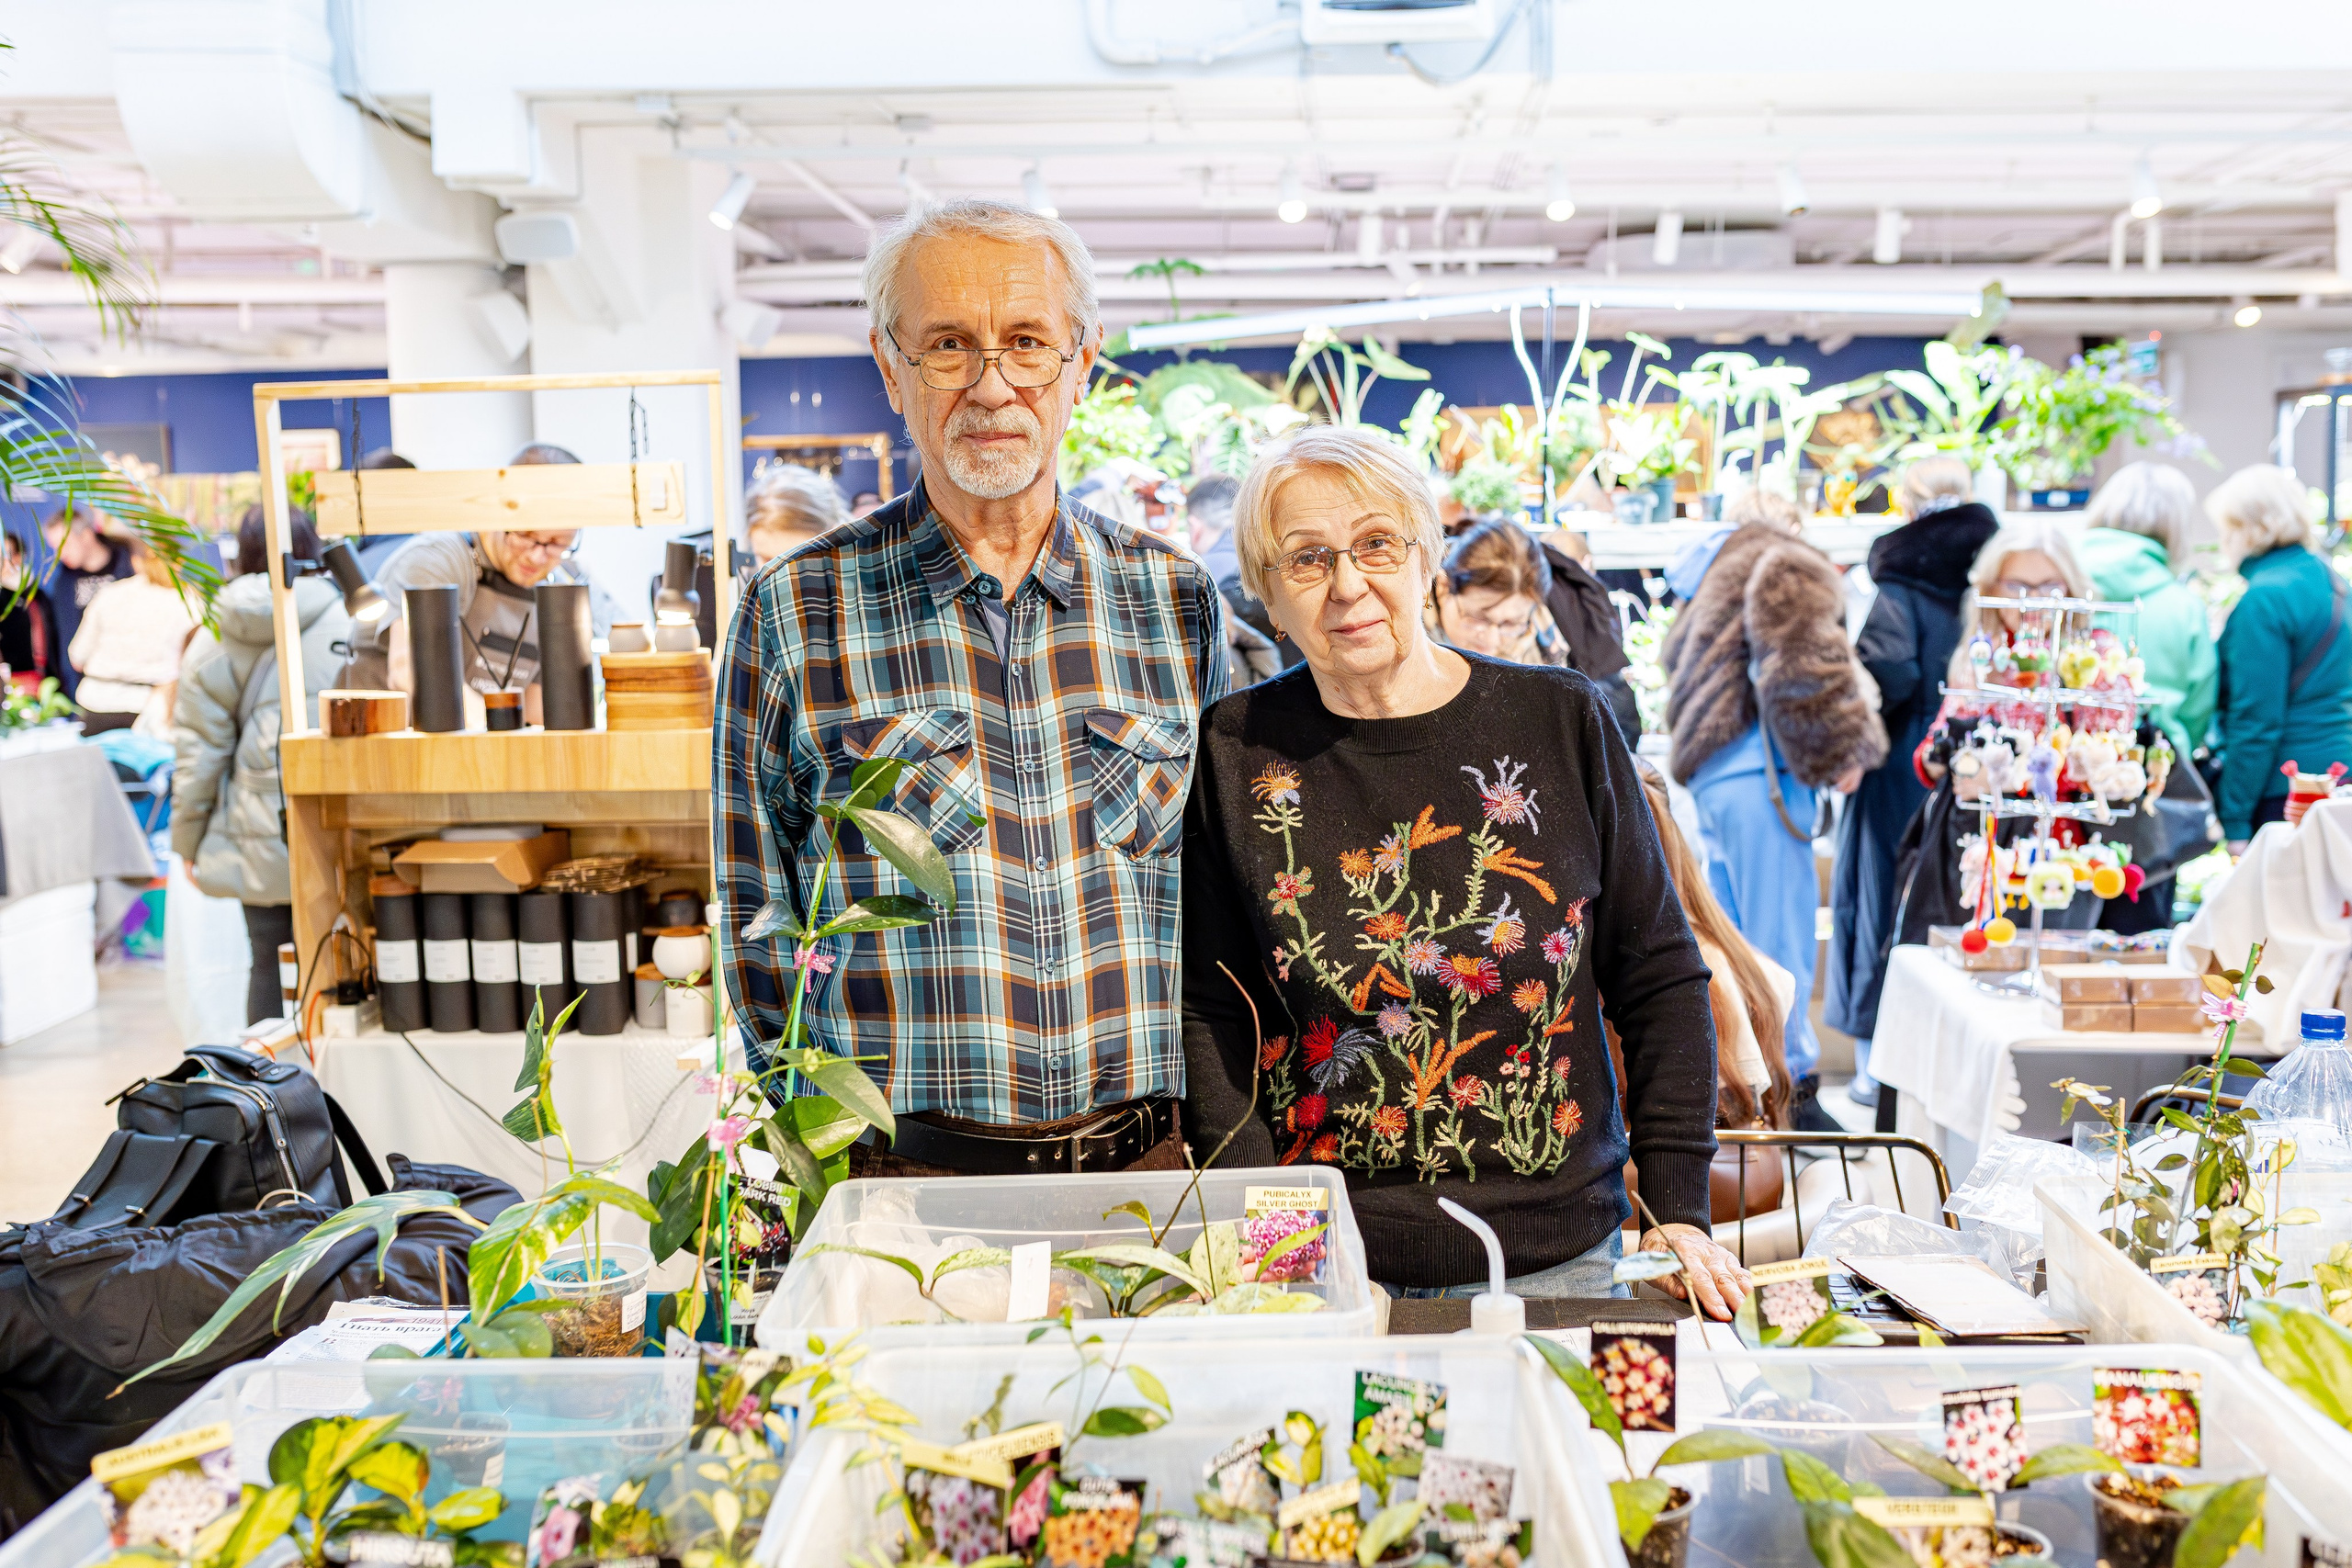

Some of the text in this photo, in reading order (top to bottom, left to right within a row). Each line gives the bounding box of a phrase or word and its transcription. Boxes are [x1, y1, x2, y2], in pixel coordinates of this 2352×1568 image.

[747, 1177, 784, 1193] LOBBII
[738, 1182, 792, 1208] DARK RED
[1256, 1200, 1318, 1208] SILVER GHOST
[339, 1322, 442, 1334] Гнать врага
